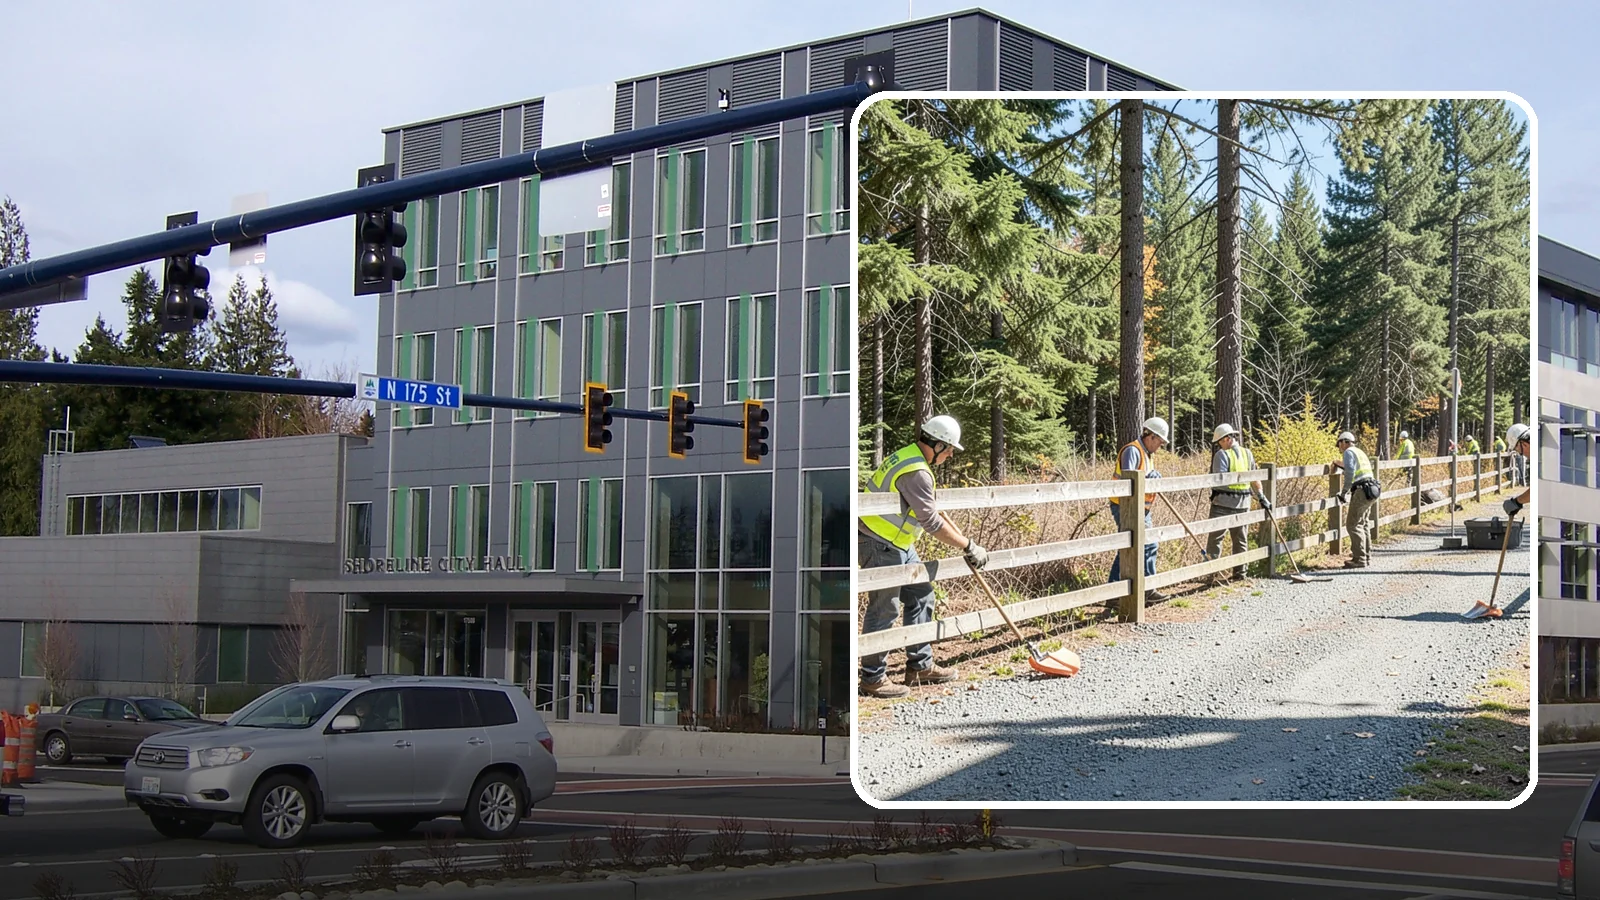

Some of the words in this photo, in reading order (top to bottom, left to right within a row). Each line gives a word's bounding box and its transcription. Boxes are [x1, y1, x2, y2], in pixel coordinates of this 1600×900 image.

[387, 381, 396, 400] N
[405, 383, 428, 403] 175
[436, 386, 452, 406] St
[344, 556, 432, 574] SHORELINE
[438, 556, 475, 573] CITY
[483, 555, 525, 572] HALL
